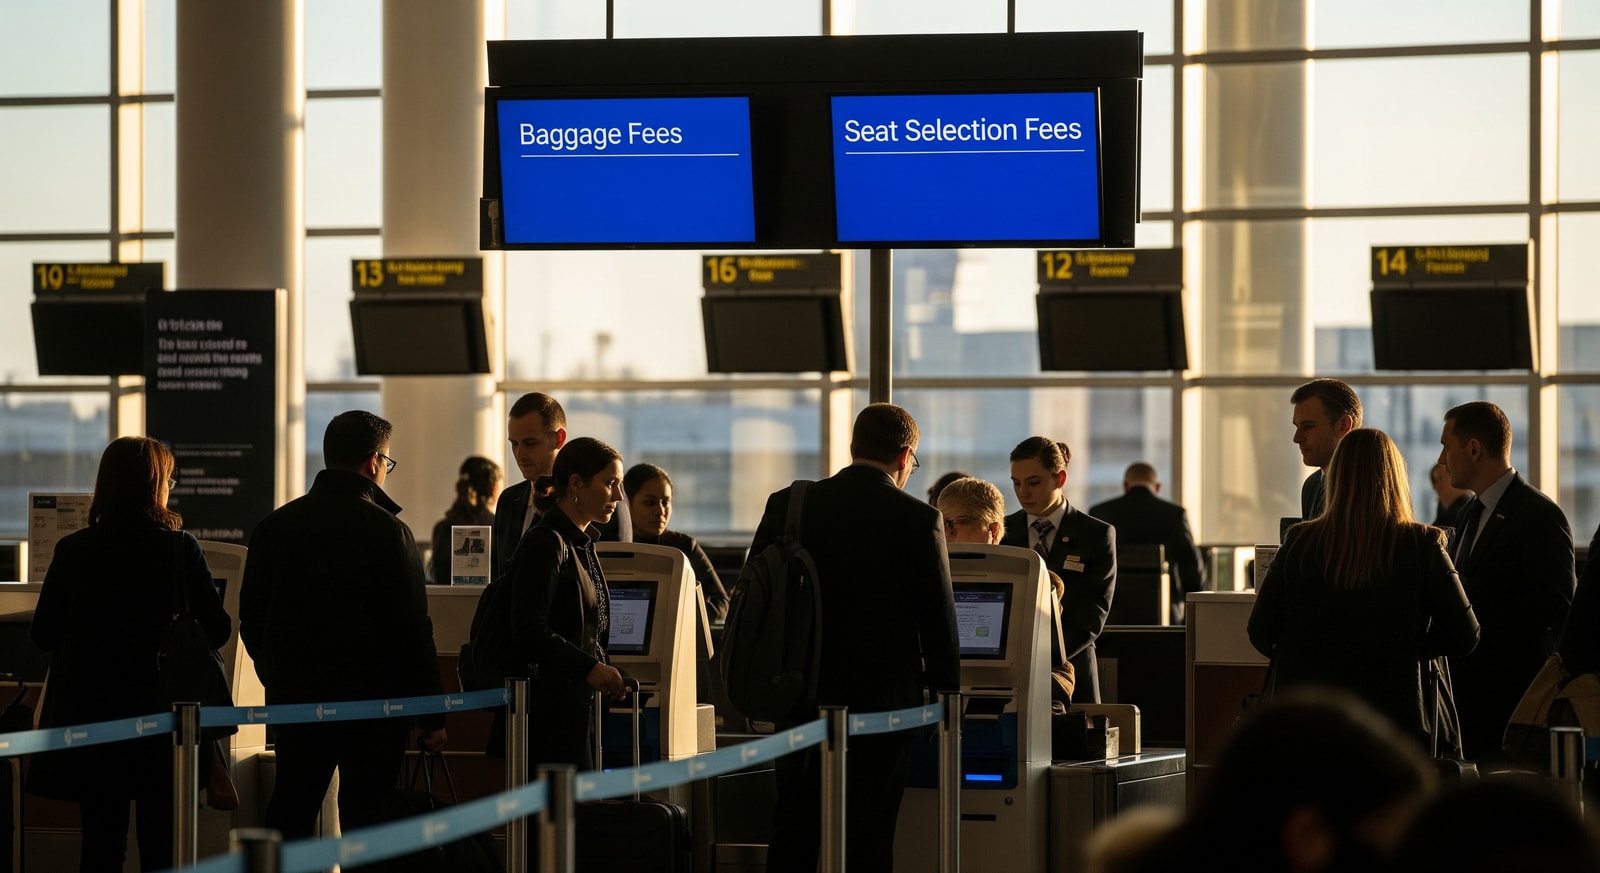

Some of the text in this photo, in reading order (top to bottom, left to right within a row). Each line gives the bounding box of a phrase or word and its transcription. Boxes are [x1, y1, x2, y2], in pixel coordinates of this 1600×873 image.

[519, 122, 682, 150] Baggage Fees
[845, 117, 1082, 142] Seat Selection Fees
[356, 261, 384, 287] 13
[707, 256, 737, 283] 16
[1042, 252, 1073, 279] 12
[1376, 248, 1407, 275] 14
[37, 264, 64, 289] 10
